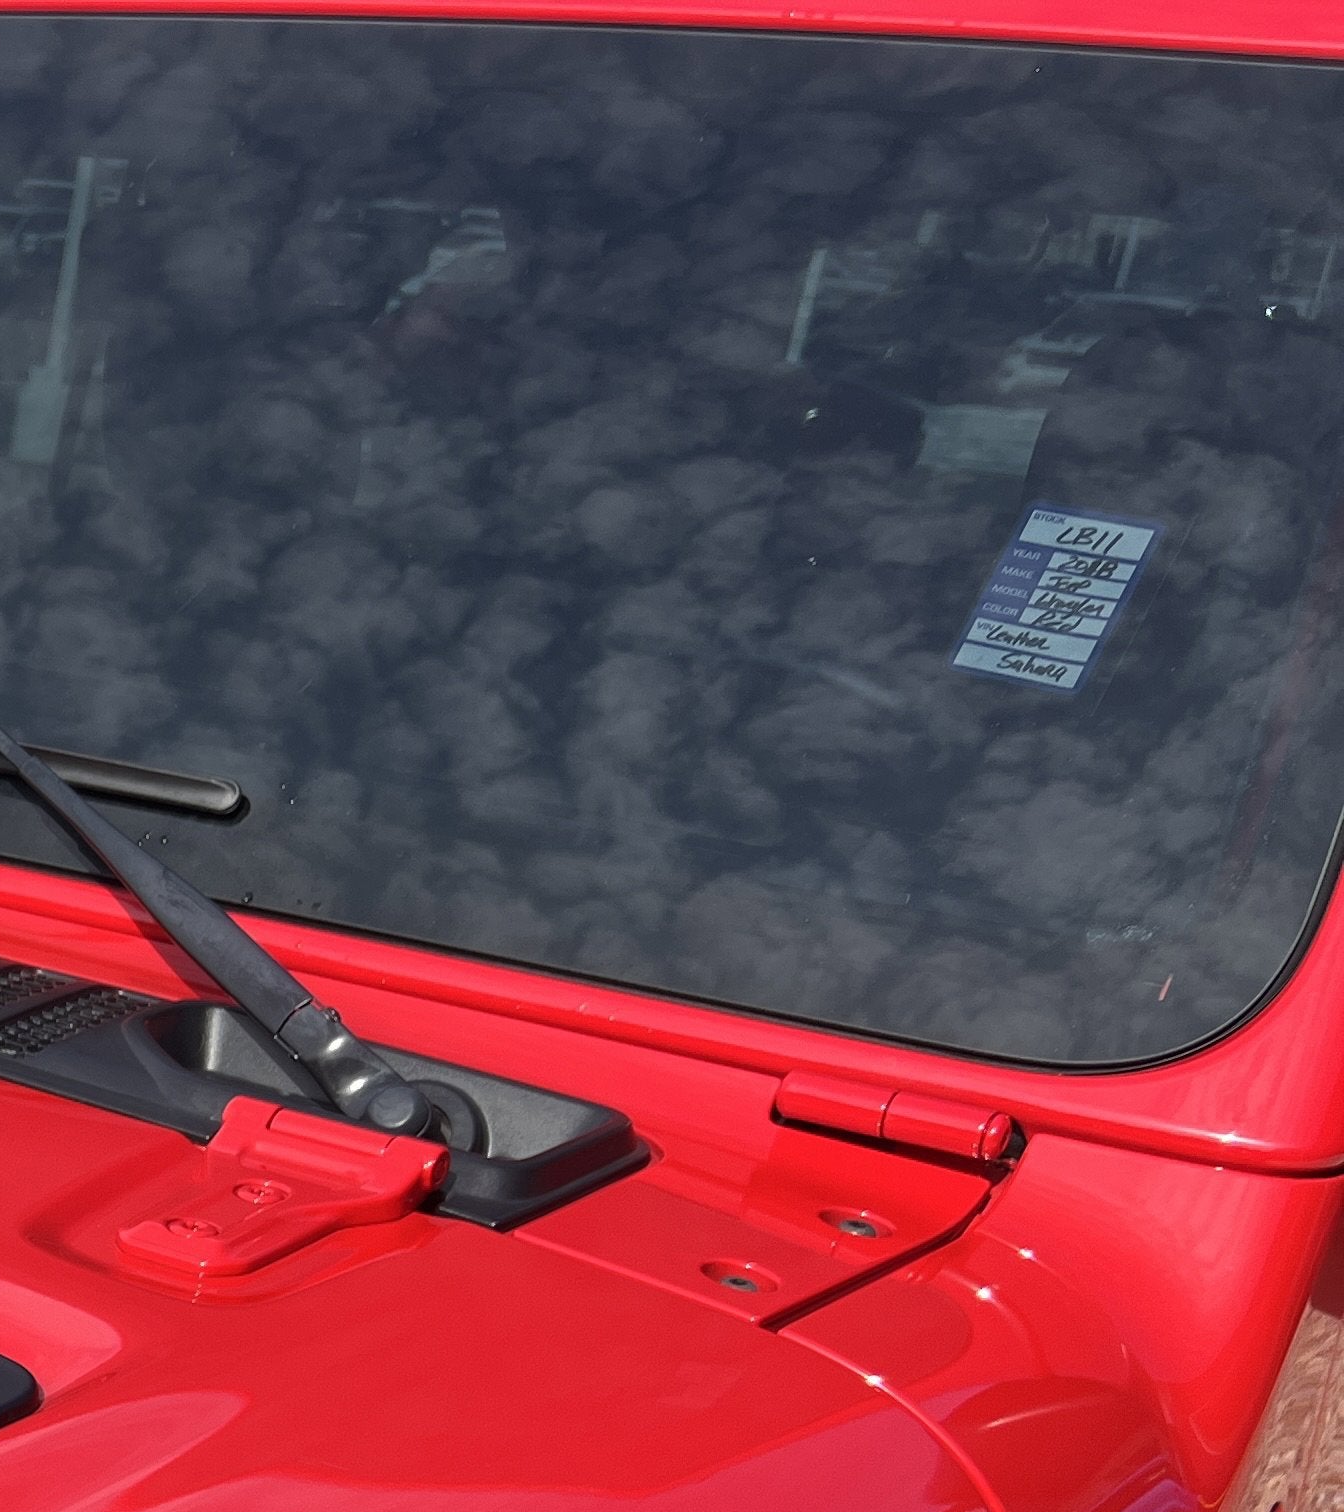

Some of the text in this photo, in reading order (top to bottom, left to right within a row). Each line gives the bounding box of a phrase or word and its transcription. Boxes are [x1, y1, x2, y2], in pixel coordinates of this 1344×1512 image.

[1013, 547, 1042, 561] YEAR
[1001, 565, 1036, 580] MAKE
[992, 584, 1029, 598] MODEL
[982, 601, 1020, 617] COLOR
[976, 621, 995, 632] VIN
